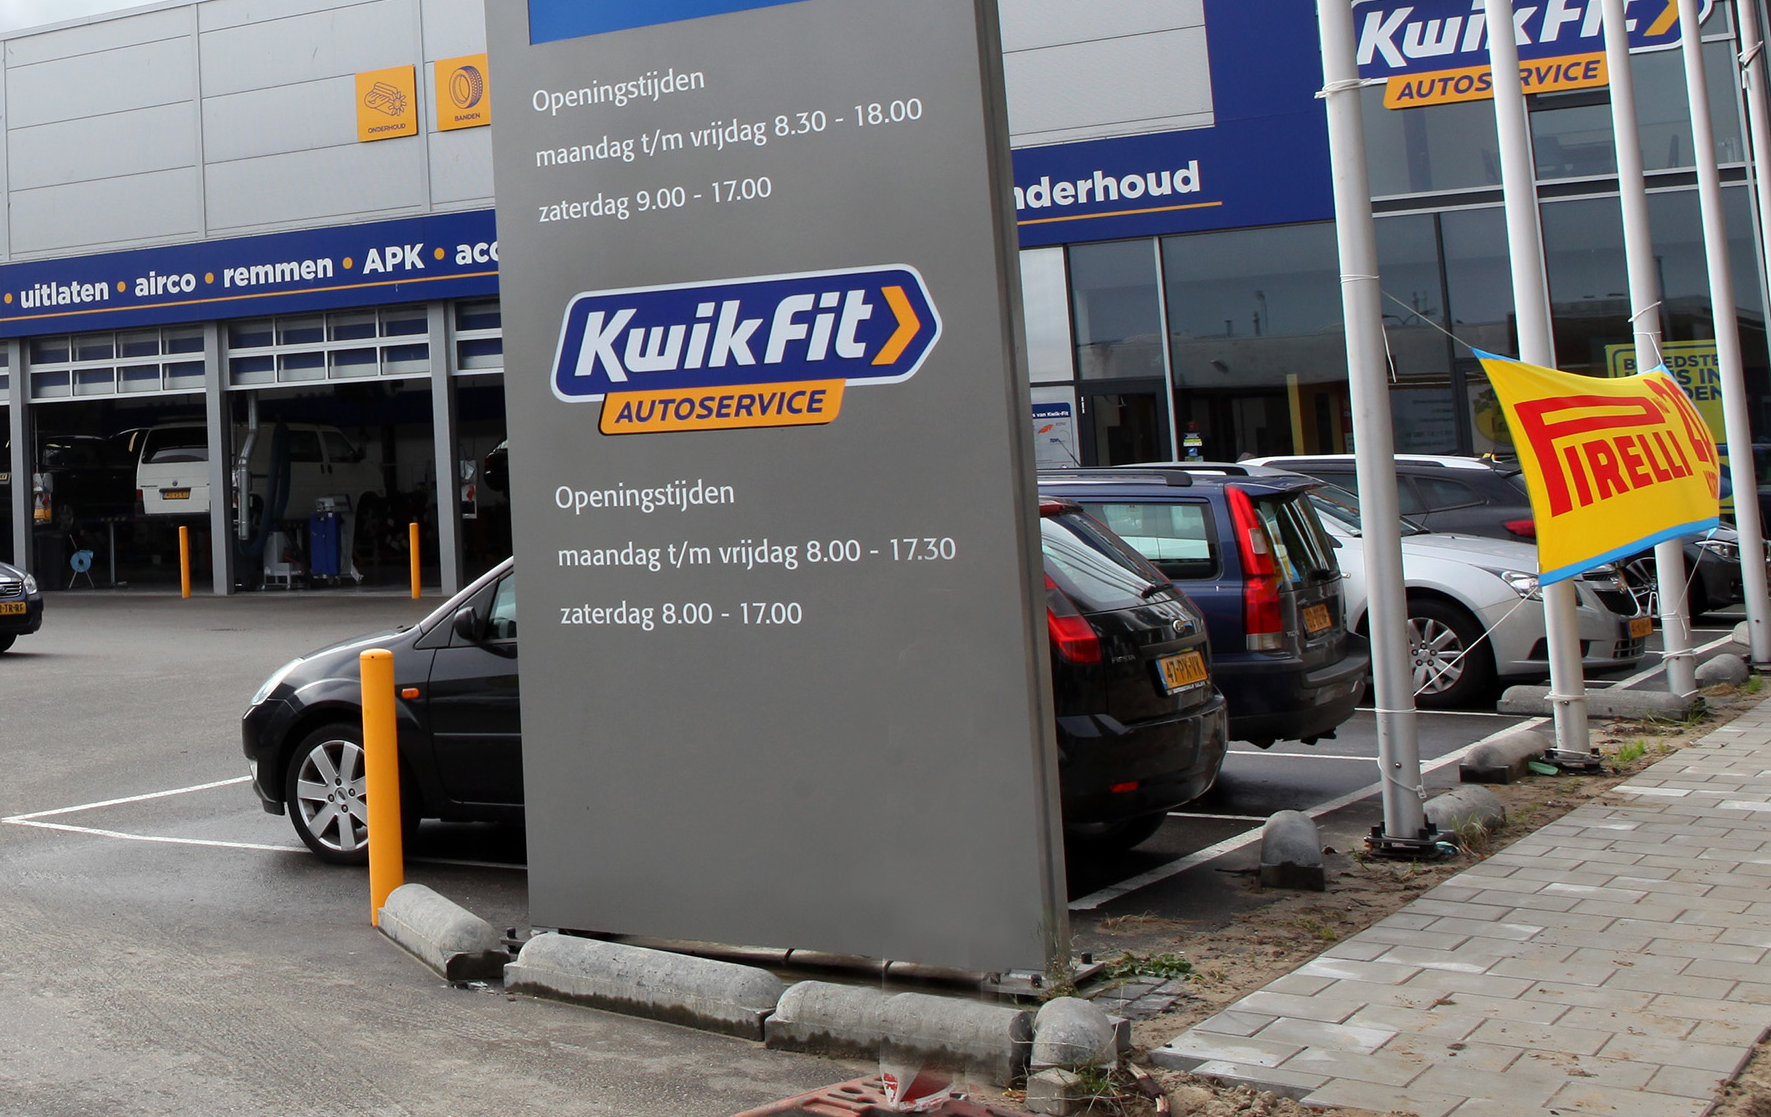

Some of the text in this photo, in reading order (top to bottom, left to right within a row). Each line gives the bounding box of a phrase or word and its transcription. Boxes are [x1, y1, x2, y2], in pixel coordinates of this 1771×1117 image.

[532, 68, 705, 116] Openingstijden
[1396, 59, 1601, 101] AUTOSRVICE
[368, 122, 407, 134] ONDERHOUD
[454, 112, 481, 122] BANDEN
[535, 135, 635, 167] maandag
[641, 128, 683, 157] t/m
[690, 118, 767, 151] vrijdag
[774, 110, 827, 137] 8.30
[854, 97, 923, 127] 18.00
[538, 192, 629, 223] zaterdag
[636, 186, 686, 212] 9.00
[711, 176, 772, 203] 17.00
[1014, 159, 1201, 210] nderhoud
[21, 280, 109, 309] uitlaten
[135, 271, 196, 297] airco
[223, 256, 333, 288] remmen
[363, 243, 425, 274] APK
[614, 388, 826, 424] AUTOSERVICE
[1514, 394, 1693, 517] PIRELLI
[555, 479, 735, 515] Openingstijden
[558, 541, 661, 571] maandag
[667, 541, 711, 568] t/m
[718, 538, 798, 569] vrijdag
[806, 539, 861, 563] 8.00
[889, 537, 956, 561] 17.30
[560, 600, 654, 630] zaterdag
[661, 602, 713, 624] 8.00
[740, 602, 803, 624] 17.00
